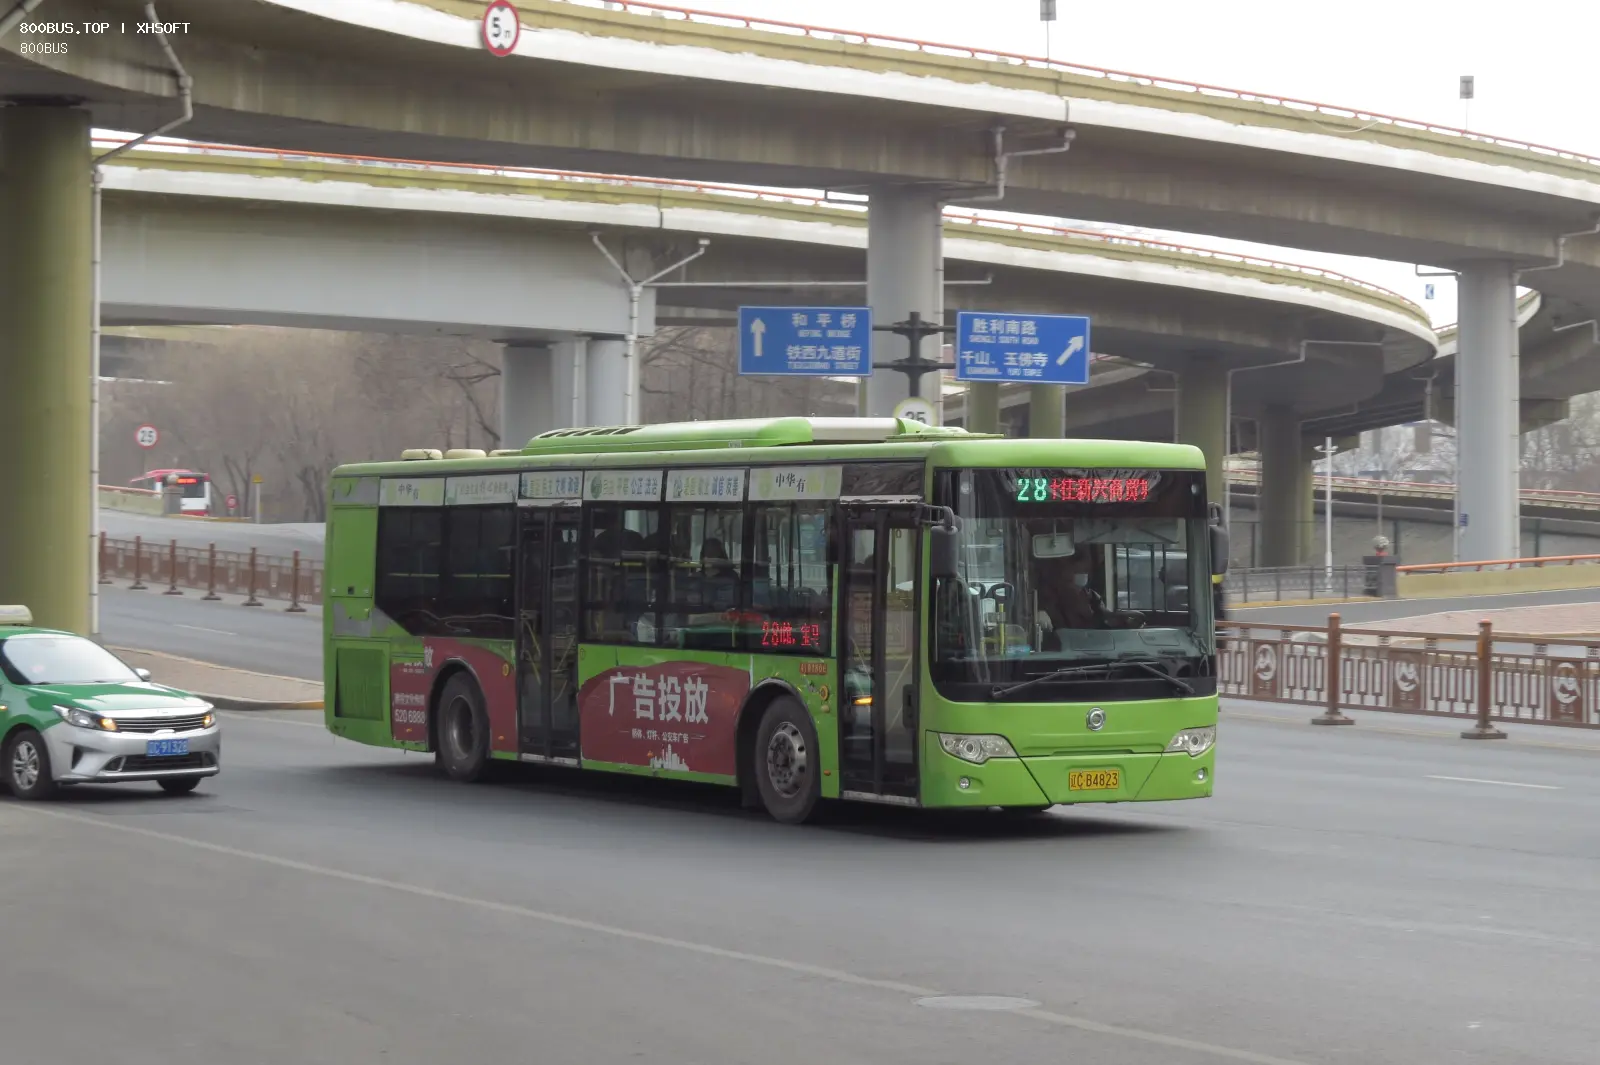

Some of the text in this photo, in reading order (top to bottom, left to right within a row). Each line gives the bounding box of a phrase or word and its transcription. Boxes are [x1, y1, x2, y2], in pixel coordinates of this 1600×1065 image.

[791, 312, 857, 328] 和平桥
[972, 318, 1037, 335] 胜利南路
[787, 344, 861, 361] 铁西九道街
[140, 430, 154, 443] 25
[1017, 478, 1047, 501] 28
[608, 671, 709, 724] 广告投放
